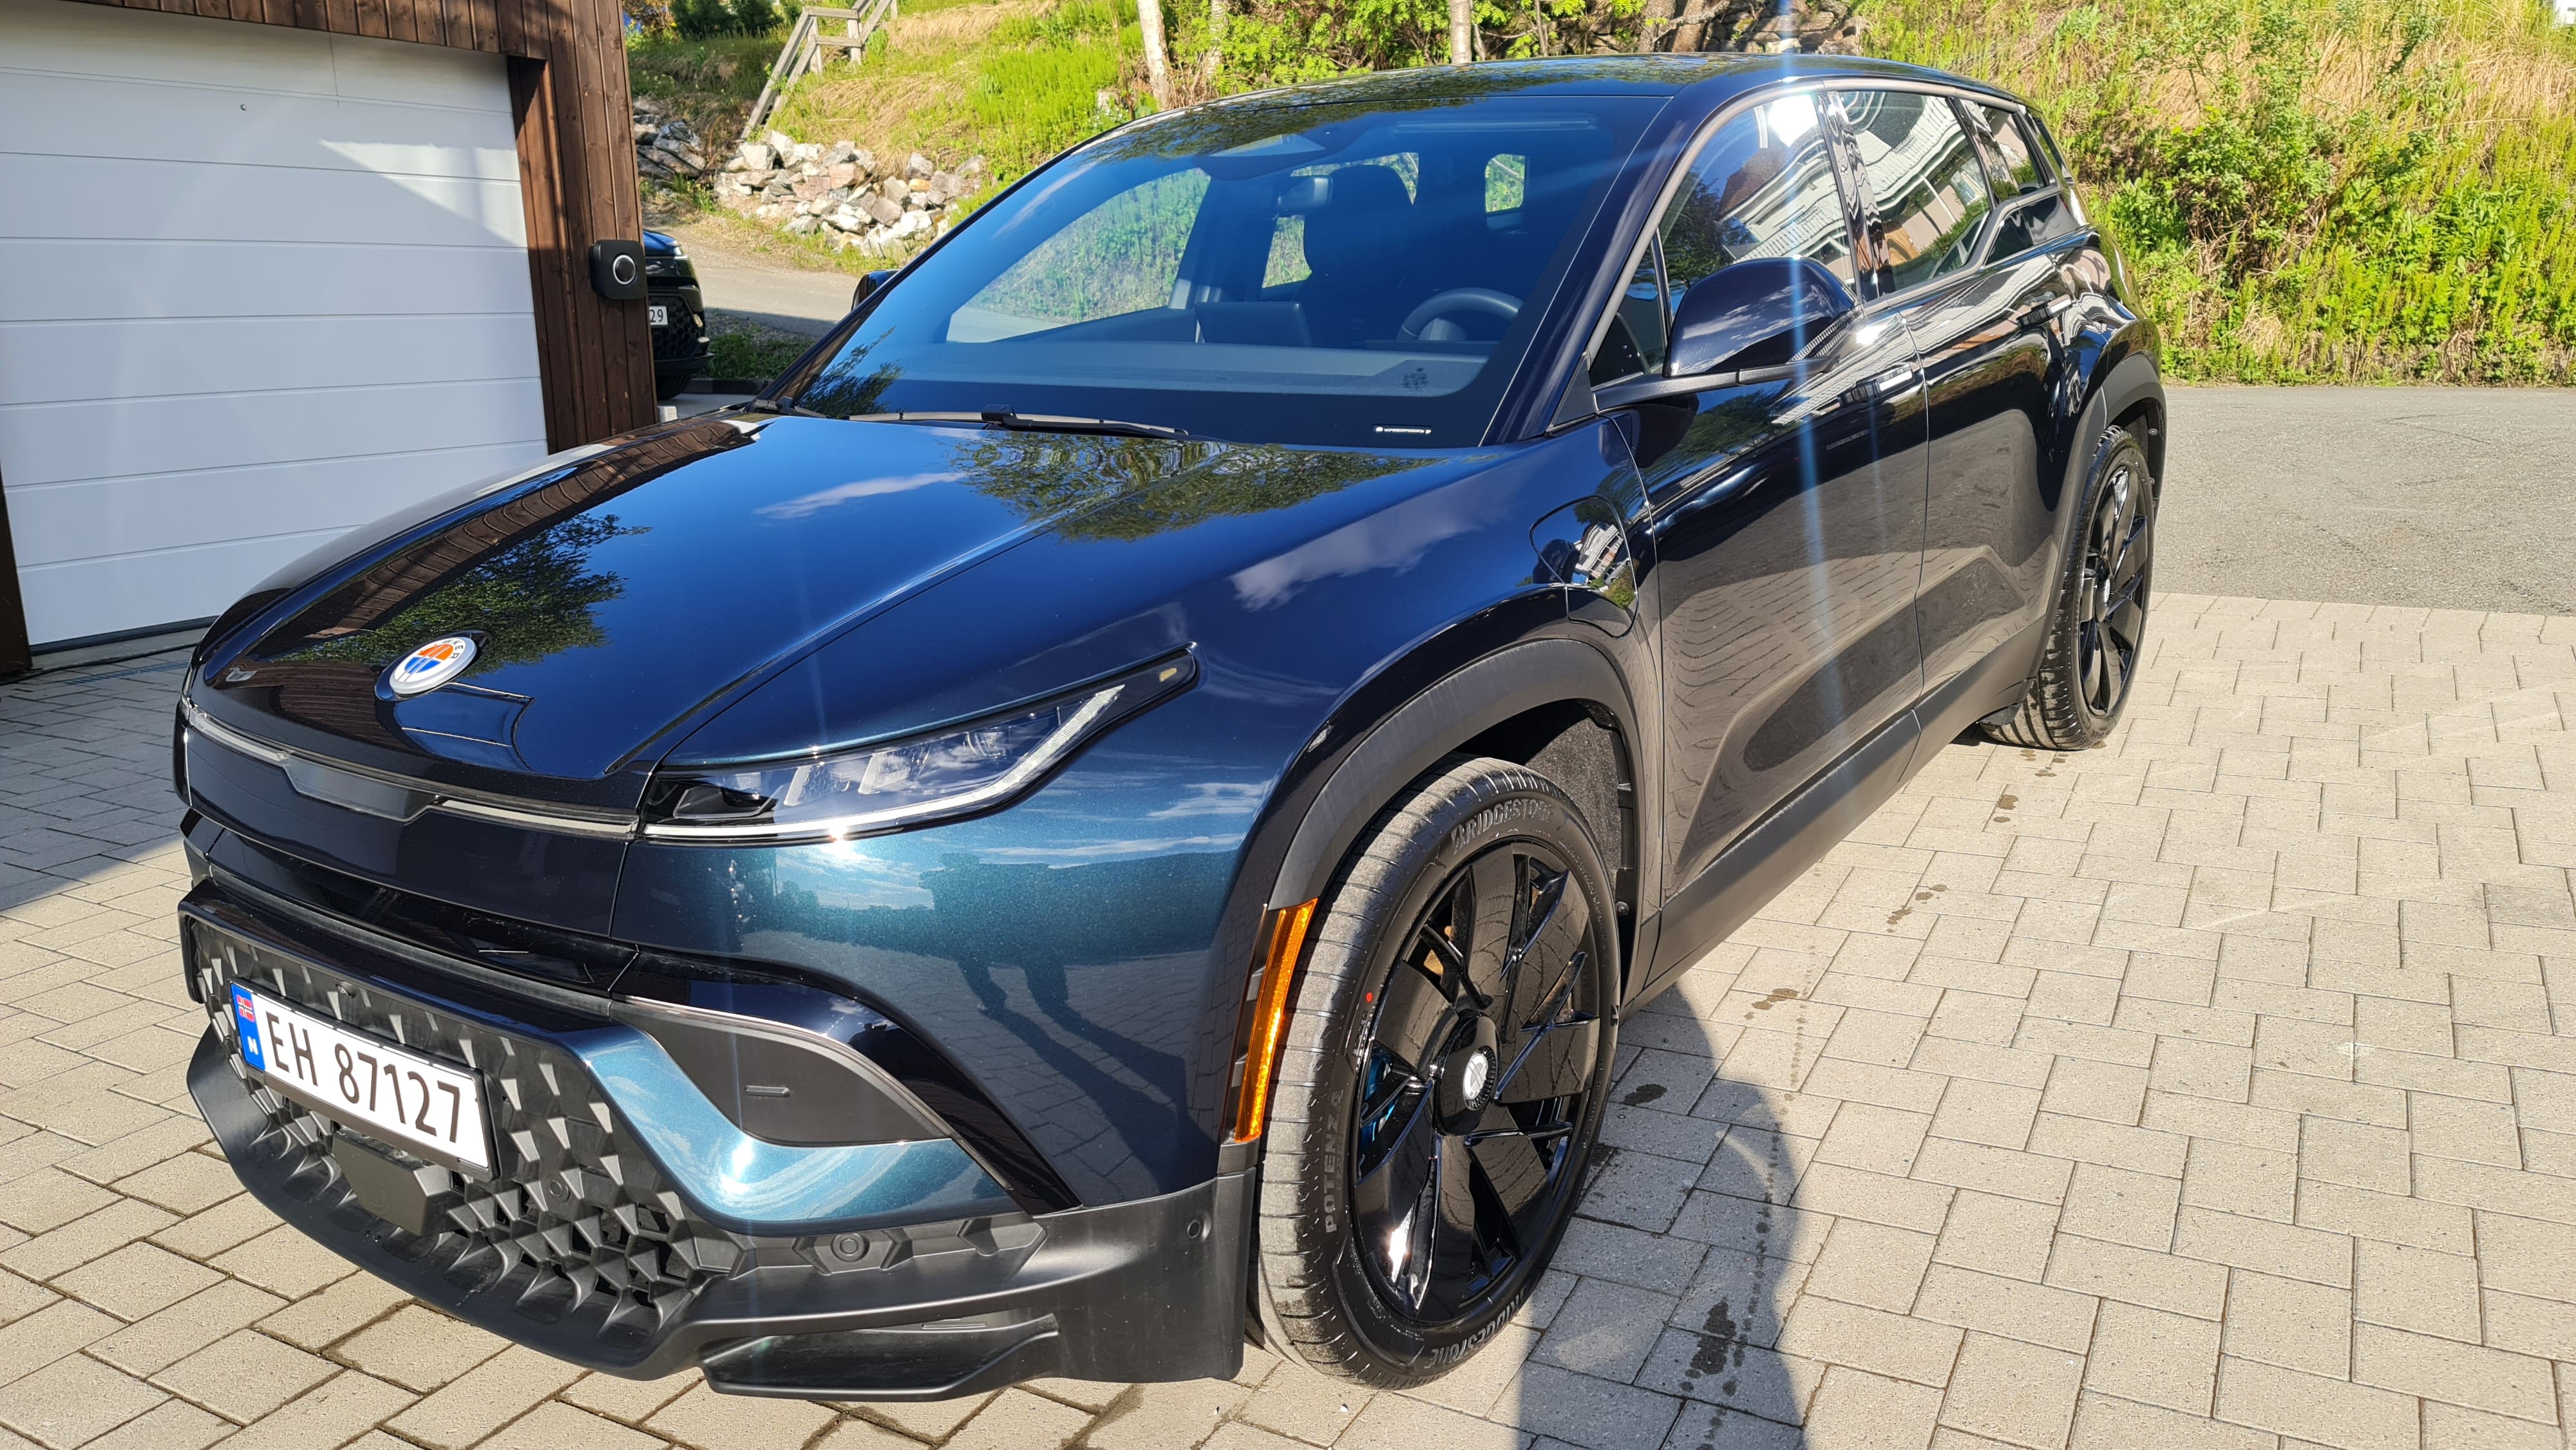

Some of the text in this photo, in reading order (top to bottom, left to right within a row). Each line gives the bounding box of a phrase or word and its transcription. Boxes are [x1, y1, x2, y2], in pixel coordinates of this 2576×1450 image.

[650, 308, 664, 323] 29
[246, 1038, 259, 1055] N
[266, 1012, 461, 1144] EH 87127
[1323, 1088, 1344, 1233] POTENZA
